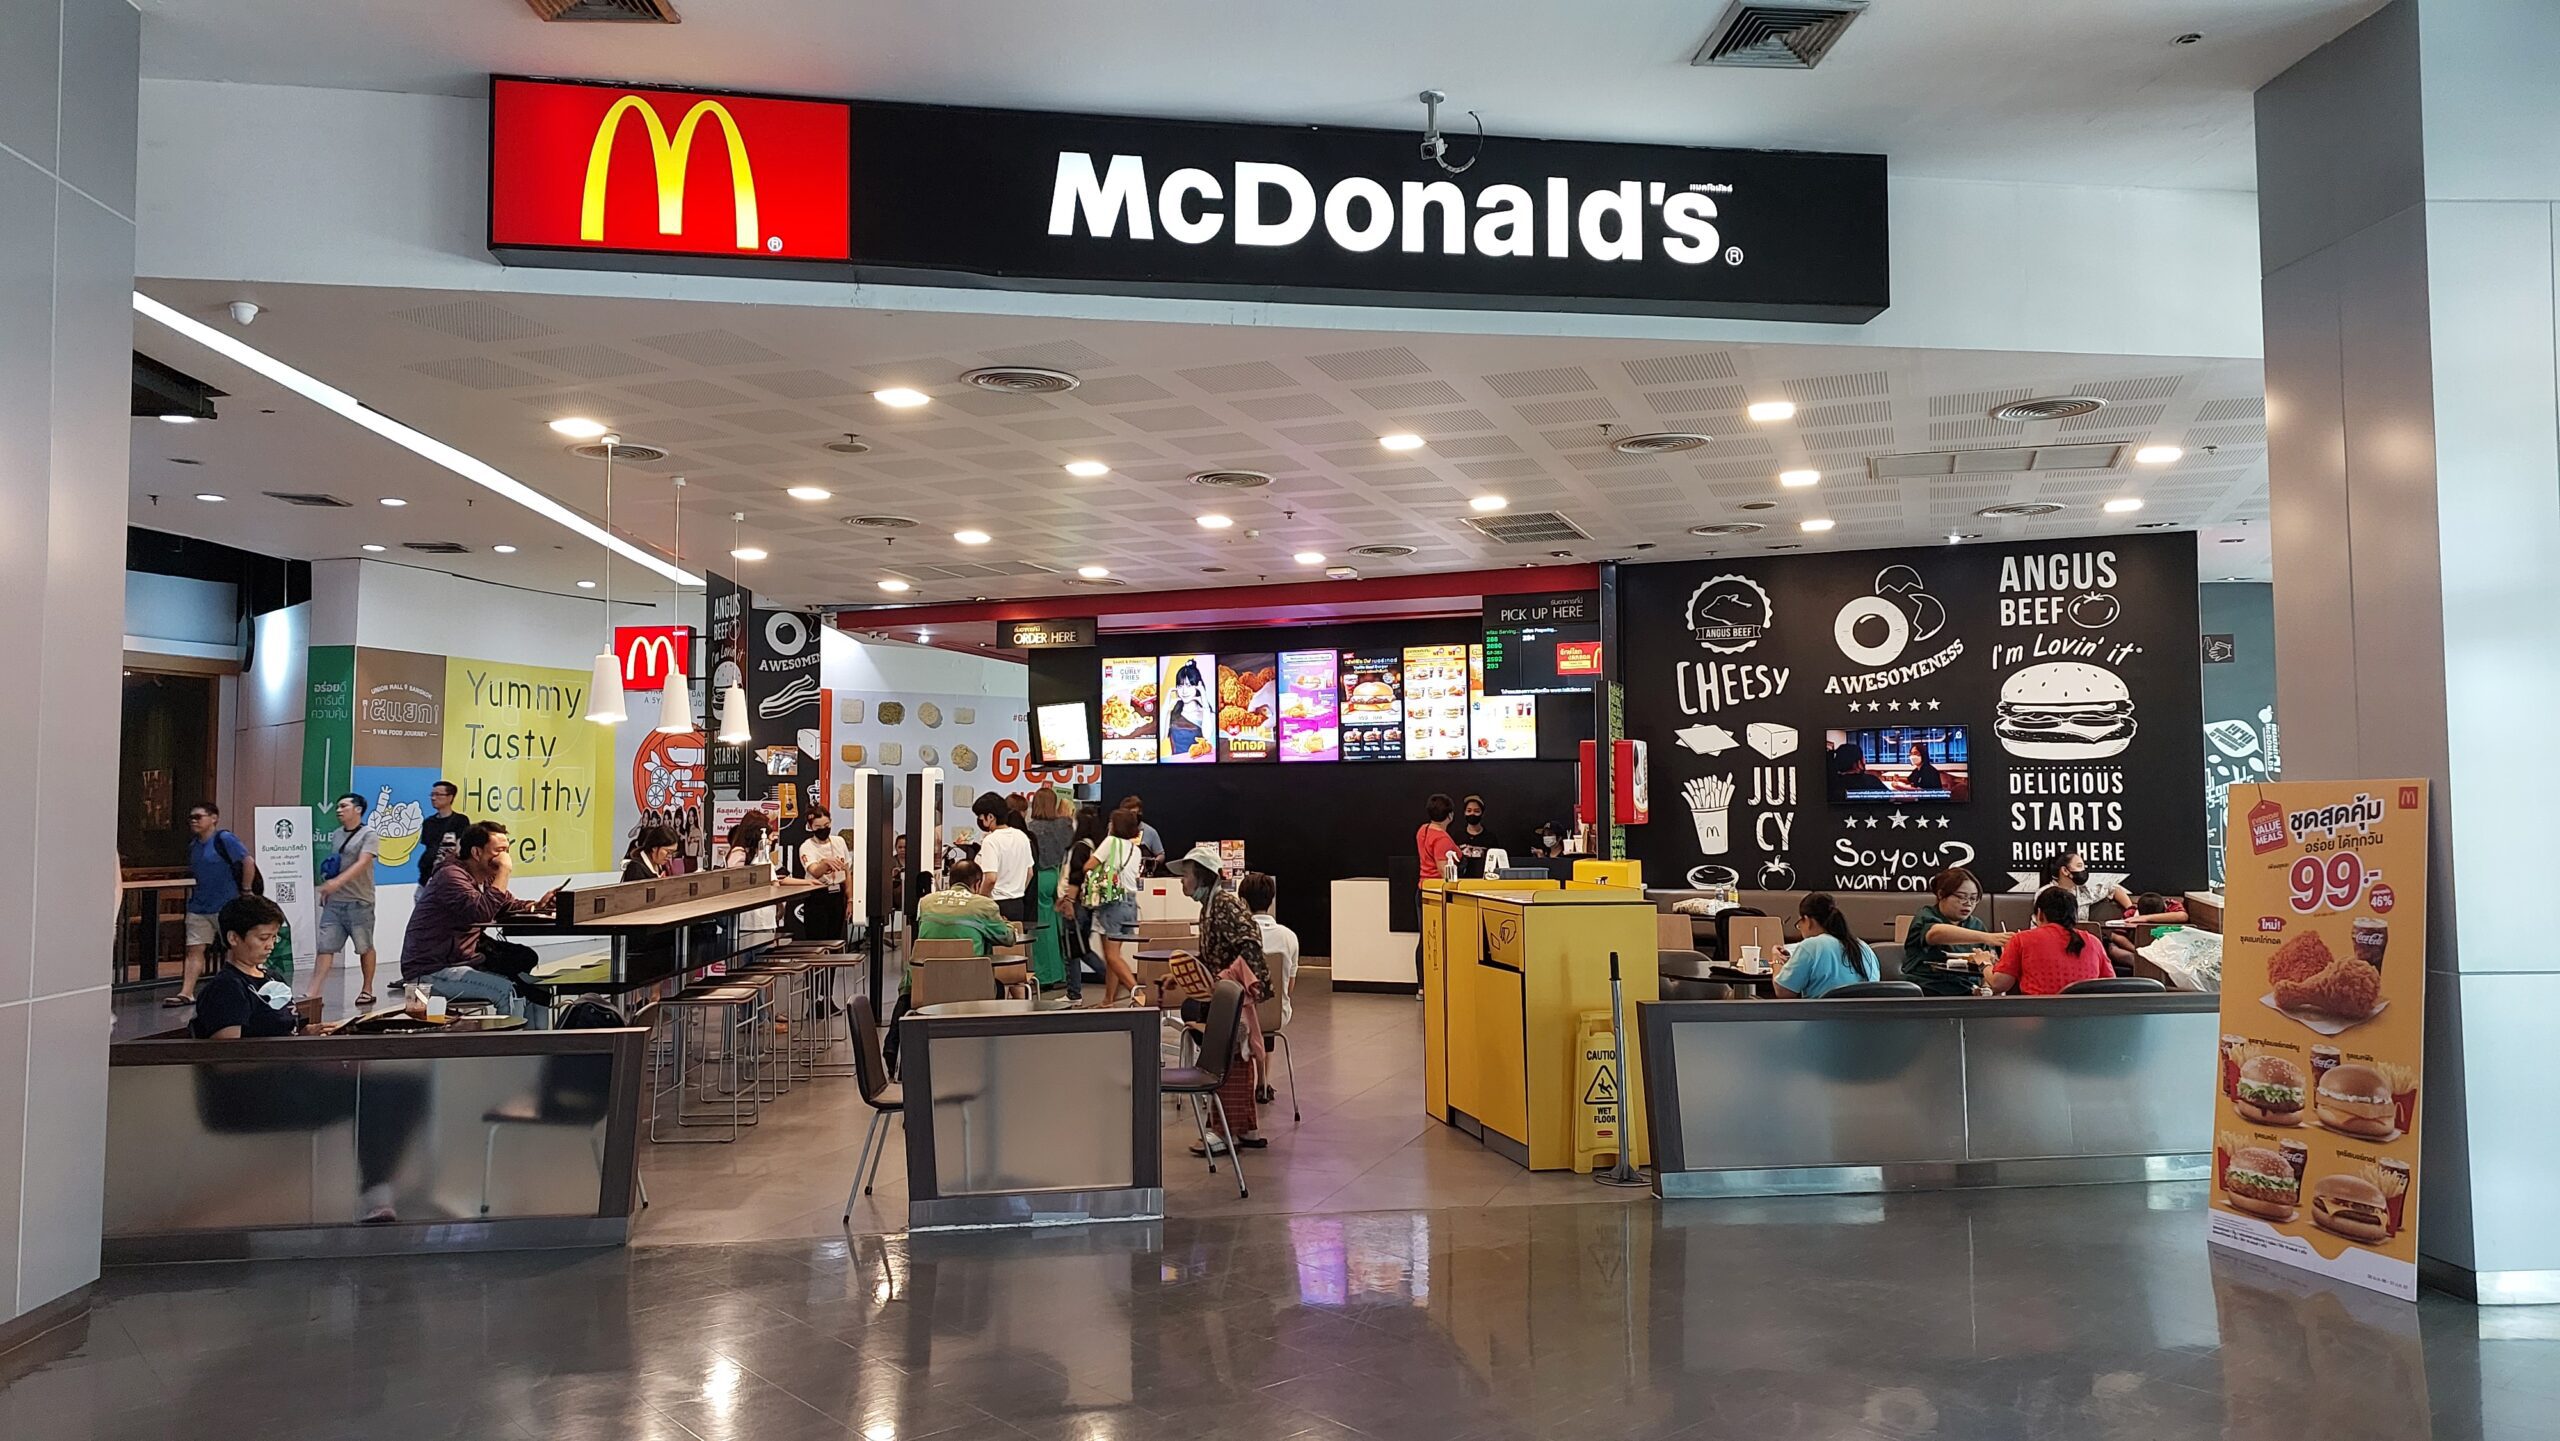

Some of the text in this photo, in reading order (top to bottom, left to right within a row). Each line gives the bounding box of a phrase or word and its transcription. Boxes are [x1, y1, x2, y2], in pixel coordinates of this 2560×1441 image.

[1047, 151, 1721, 266] McDonald's
[1999, 550, 2117, 593] ANGUS
[713, 592, 741, 621] ANGUS
[1501, 605, 1583, 621] PICK UP HERE
[2000, 596, 2064, 627] BEEF
[713, 622, 729, 641] BEEF
[1013, 631, 1077, 645] ORDER HERE
[1705, 627, 1752, 638] ANGUS BEEF
[1992, 643, 2024, 670] I'm
[2032, 633, 2105, 658] Lovin'
[1824, 638, 1965, 695] AWESOMENESS
[466, 669, 582, 719] Yummy
[1677, 661, 1790, 715] CHEESY
[465, 724, 557, 768] Tasty
[1229, 737, 1266, 751] ไก่ทอด
[713, 746, 740, 766] STARTS
[2009, 771, 2124, 795] DELICIOUS
[462, 777, 591, 818] Healthy
[2011, 802, 2123, 831] STARTS
[2290, 795, 2381, 839] ชุดสุดคุ้ม
[2253, 820, 2282, 836] VALUE
[2255, 831, 2284, 846] MEALS
[2012, 842, 2126, 863] RIGHT HERE
[2305, 832, 2384, 853] อร่อย ได้ทุกวัน
[1835, 867, 1898, 891] want
[2371, 896, 2393, 907] 46%
[1586, 1050, 1616, 1061] CAUTIO
[1593, 1115, 1616, 1123] FLOOR
[1597, 1106, 1612, 1115] WET
